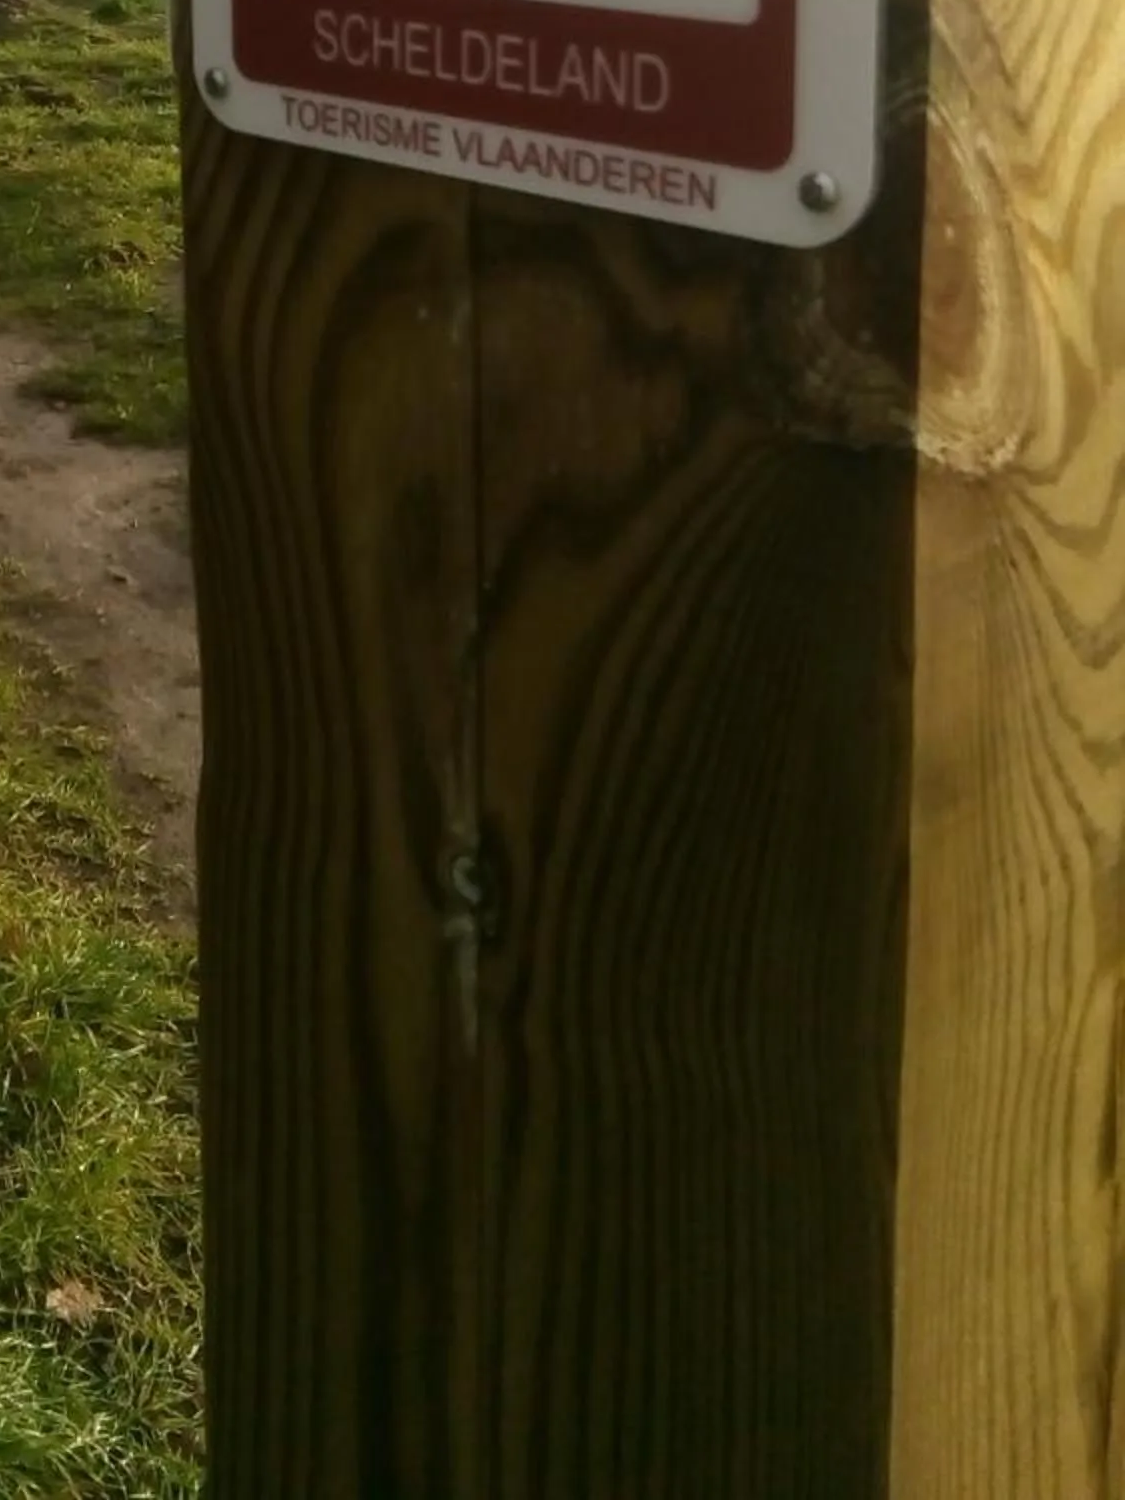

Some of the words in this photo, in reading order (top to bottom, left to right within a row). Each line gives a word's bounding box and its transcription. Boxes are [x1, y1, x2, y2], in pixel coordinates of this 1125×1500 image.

[312, 8, 672, 113] SCHELDELAND
[281, 95, 442, 156] TOERISME
[452, 130, 717, 212] VLAANDEREN
